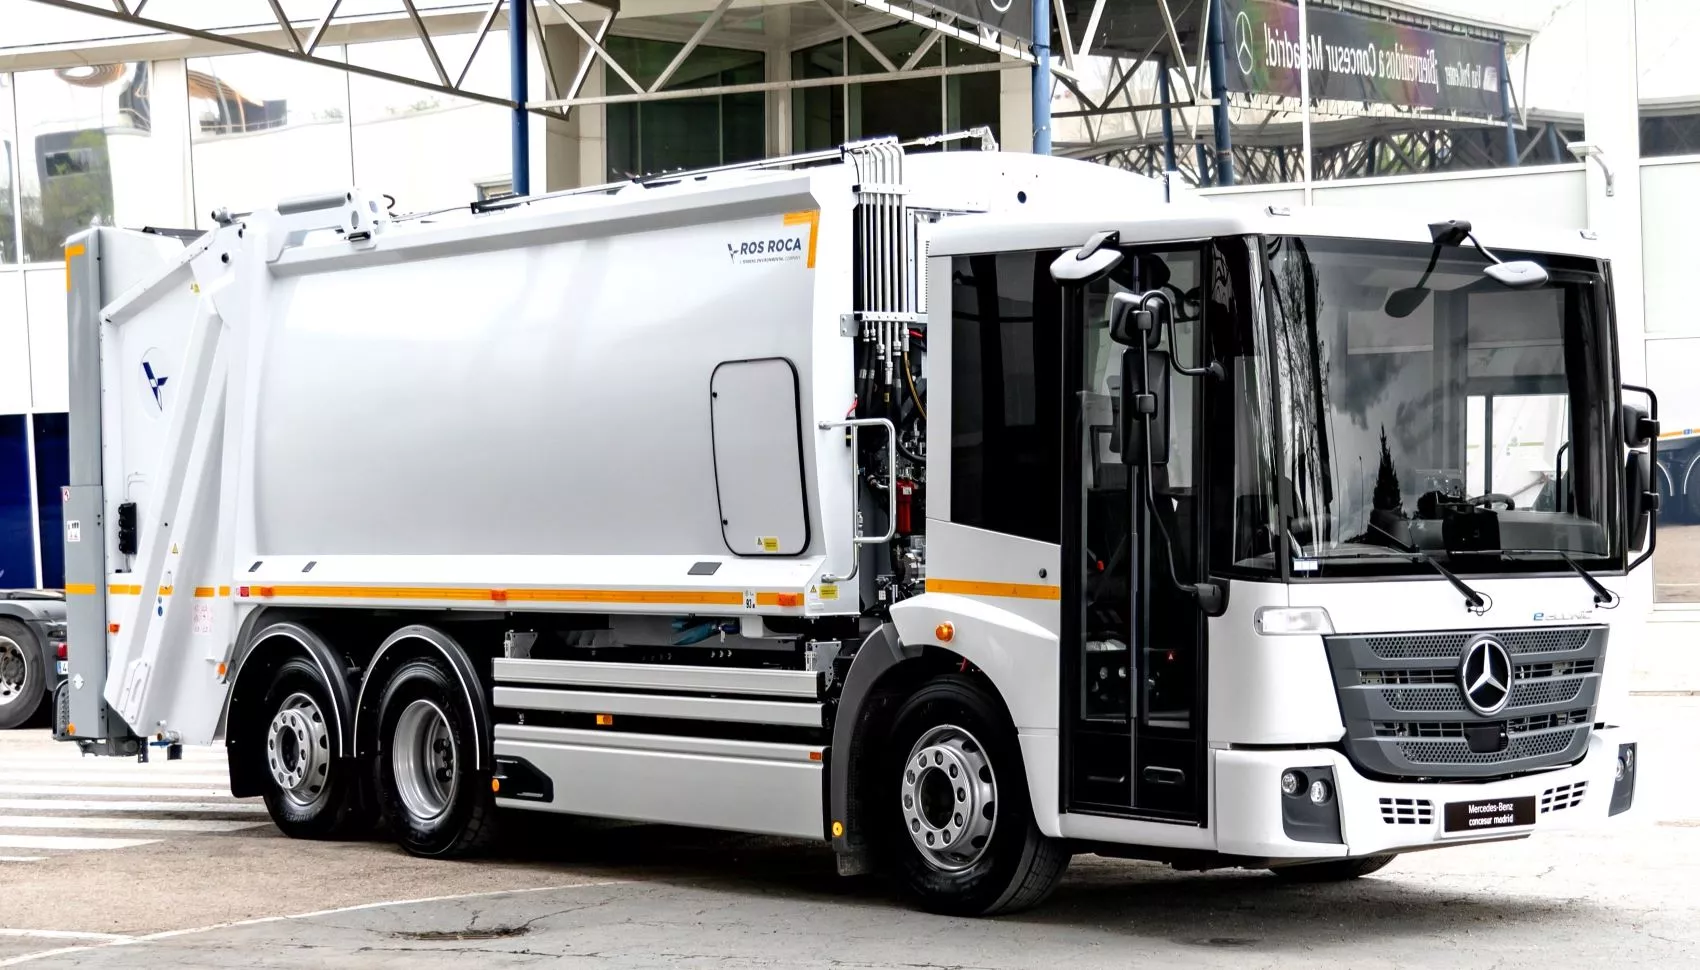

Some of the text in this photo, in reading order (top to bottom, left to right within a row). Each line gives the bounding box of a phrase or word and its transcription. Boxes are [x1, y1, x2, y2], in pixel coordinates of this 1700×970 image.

[740, 237, 801, 255] ROS ROCA
[1468, 802, 1514, 814] Mercedes-Benz
[1468, 813, 1514, 827] concesur madrid
